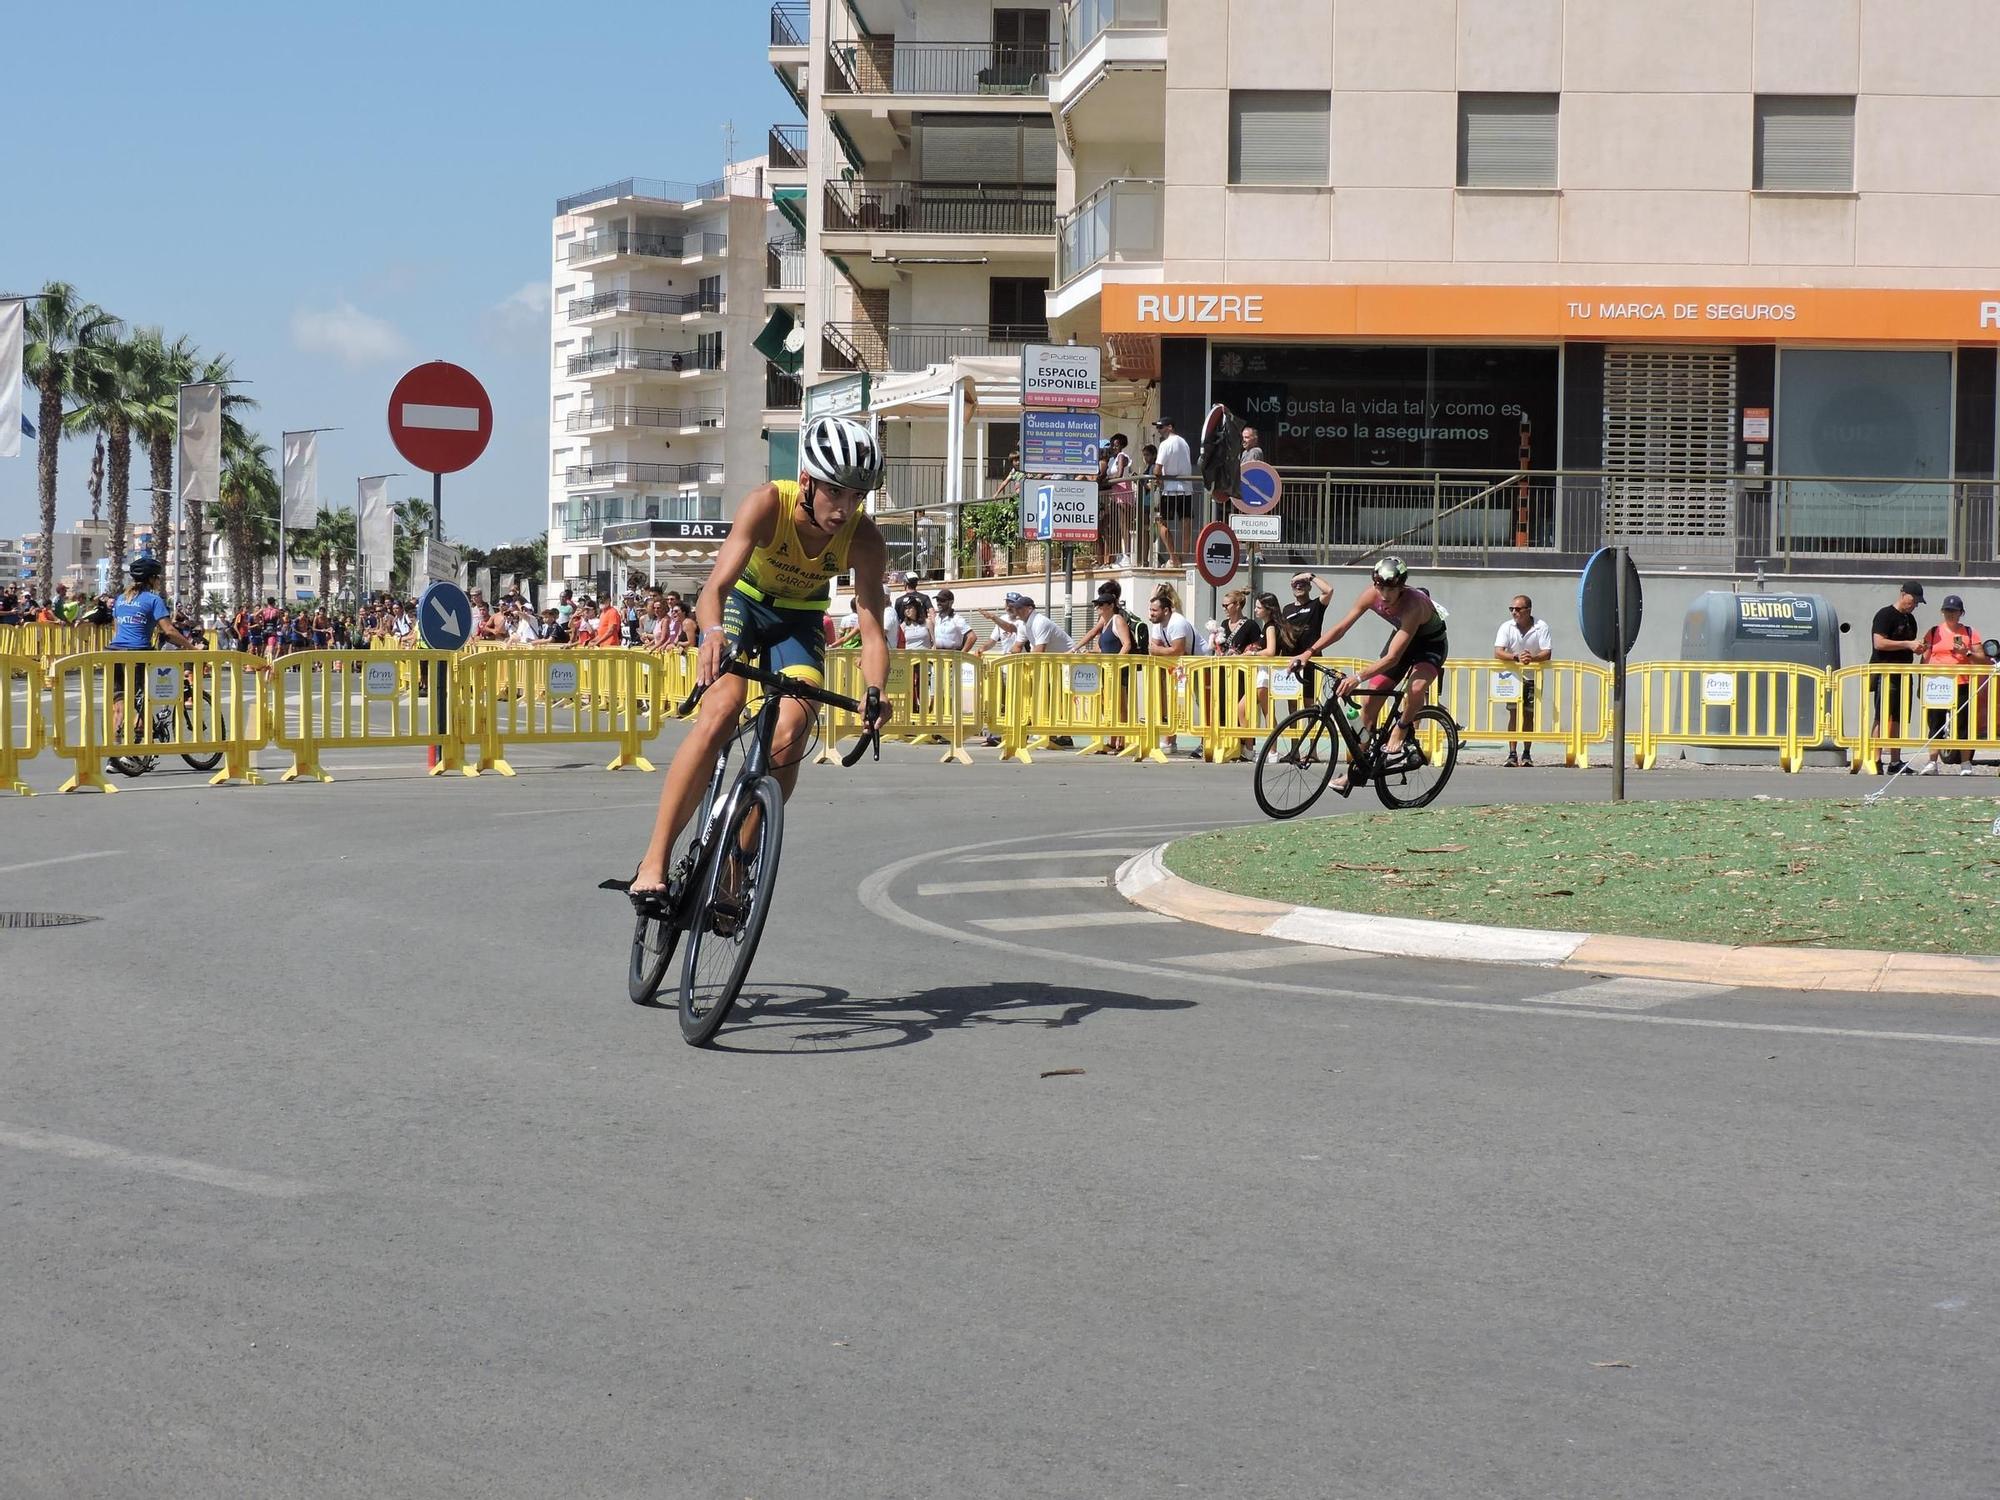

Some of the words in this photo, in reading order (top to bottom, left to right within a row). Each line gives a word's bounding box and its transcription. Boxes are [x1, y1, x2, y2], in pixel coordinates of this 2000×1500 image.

[1137, 294, 1264, 322] RUIZRE
[1567, 303, 1591, 319] TU
[1600, 303, 1666, 320] MARCA
[1673, 304, 1698, 320] DE
[1705, 304, 1796, 321] SEGUROS
[1038, 367, 1088, 379] ESPACIO
[1028, 378, 1097, 390] DISPONIBLE
[1246, 397, 1281, 414] Nos
[1286, 399, 1334, 416] gusta
[1341, 398, 1357, 414] la
[1361, 398, 1398, 415] vida
[1403, 398, 1424, 415] tal
[1429, 402, 1440, 418] y
[1445, 402, 1495, 416] como
[1027, 419, 1065, 429] Quesada
[1067, 420, 1097, 430] Market
[1278, 422, 1309, 437] Por
[1315, 424, 1348, 438] eso
[1354, 422, 1369, 438] la
[1375, 425, 1490, 441] aseguramos
[680, 524, 714, 536] BAR
[1741, 602, 1792, 619] DENTRO
